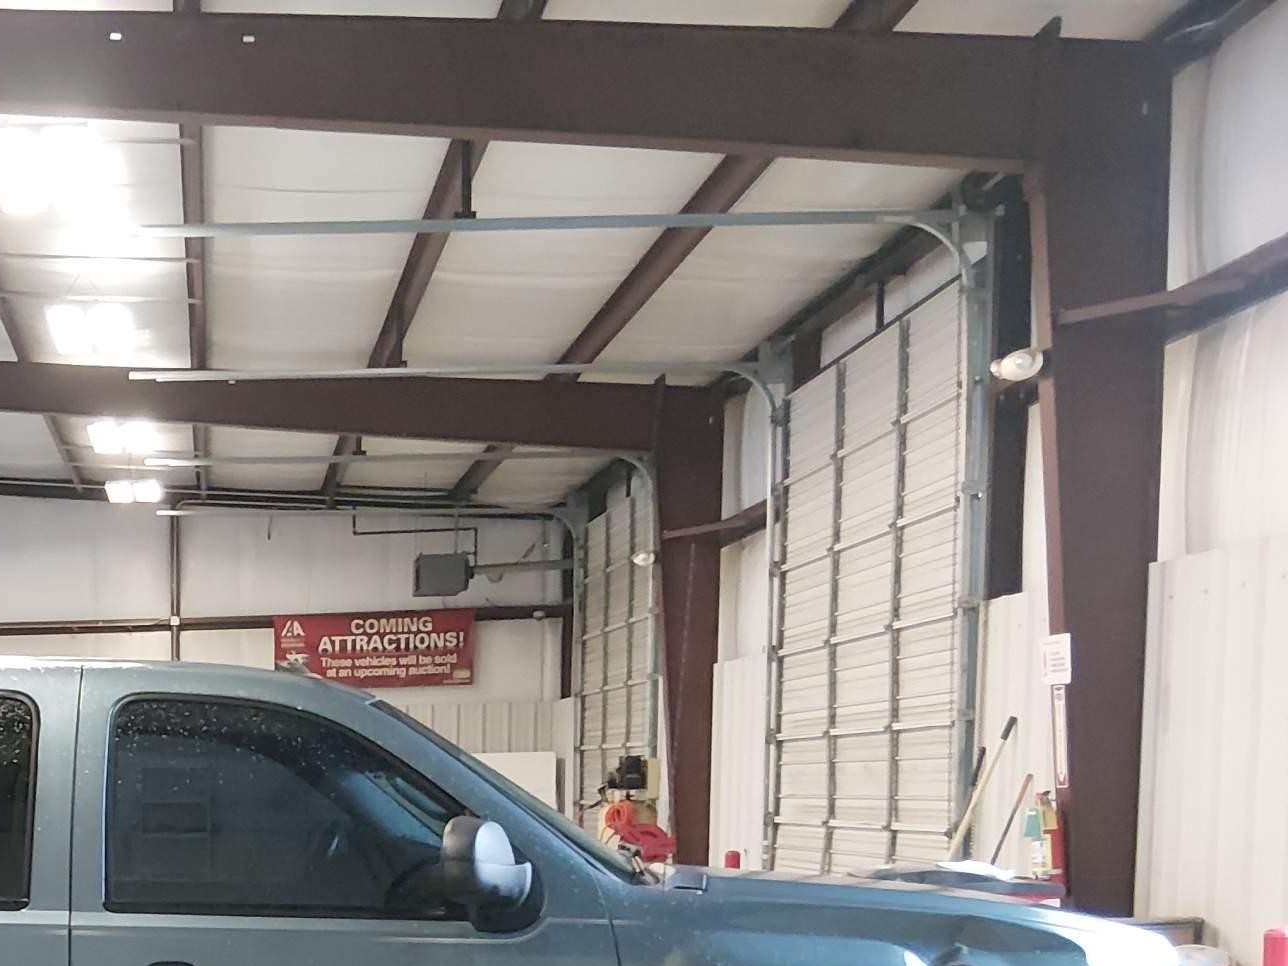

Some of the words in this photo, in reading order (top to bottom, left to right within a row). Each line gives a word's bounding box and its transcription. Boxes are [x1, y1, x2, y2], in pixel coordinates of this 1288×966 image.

[350, 616, 433, 634] COMING
[318, 631, 465, 654] ATTRACTIONS!
[320, 657, 352, 668] These
[354, 655, 397, 667] vehicles
[399, 655, 417, 665] will
[419, 655, 432, 665] be
[434, 653, 457, 664] sold
[326, 668, 336, 678] at
[338, 669, 352, 677] an
[354, 667, 406, 679] upcoming
[408, 664, 451, 676] auction!
